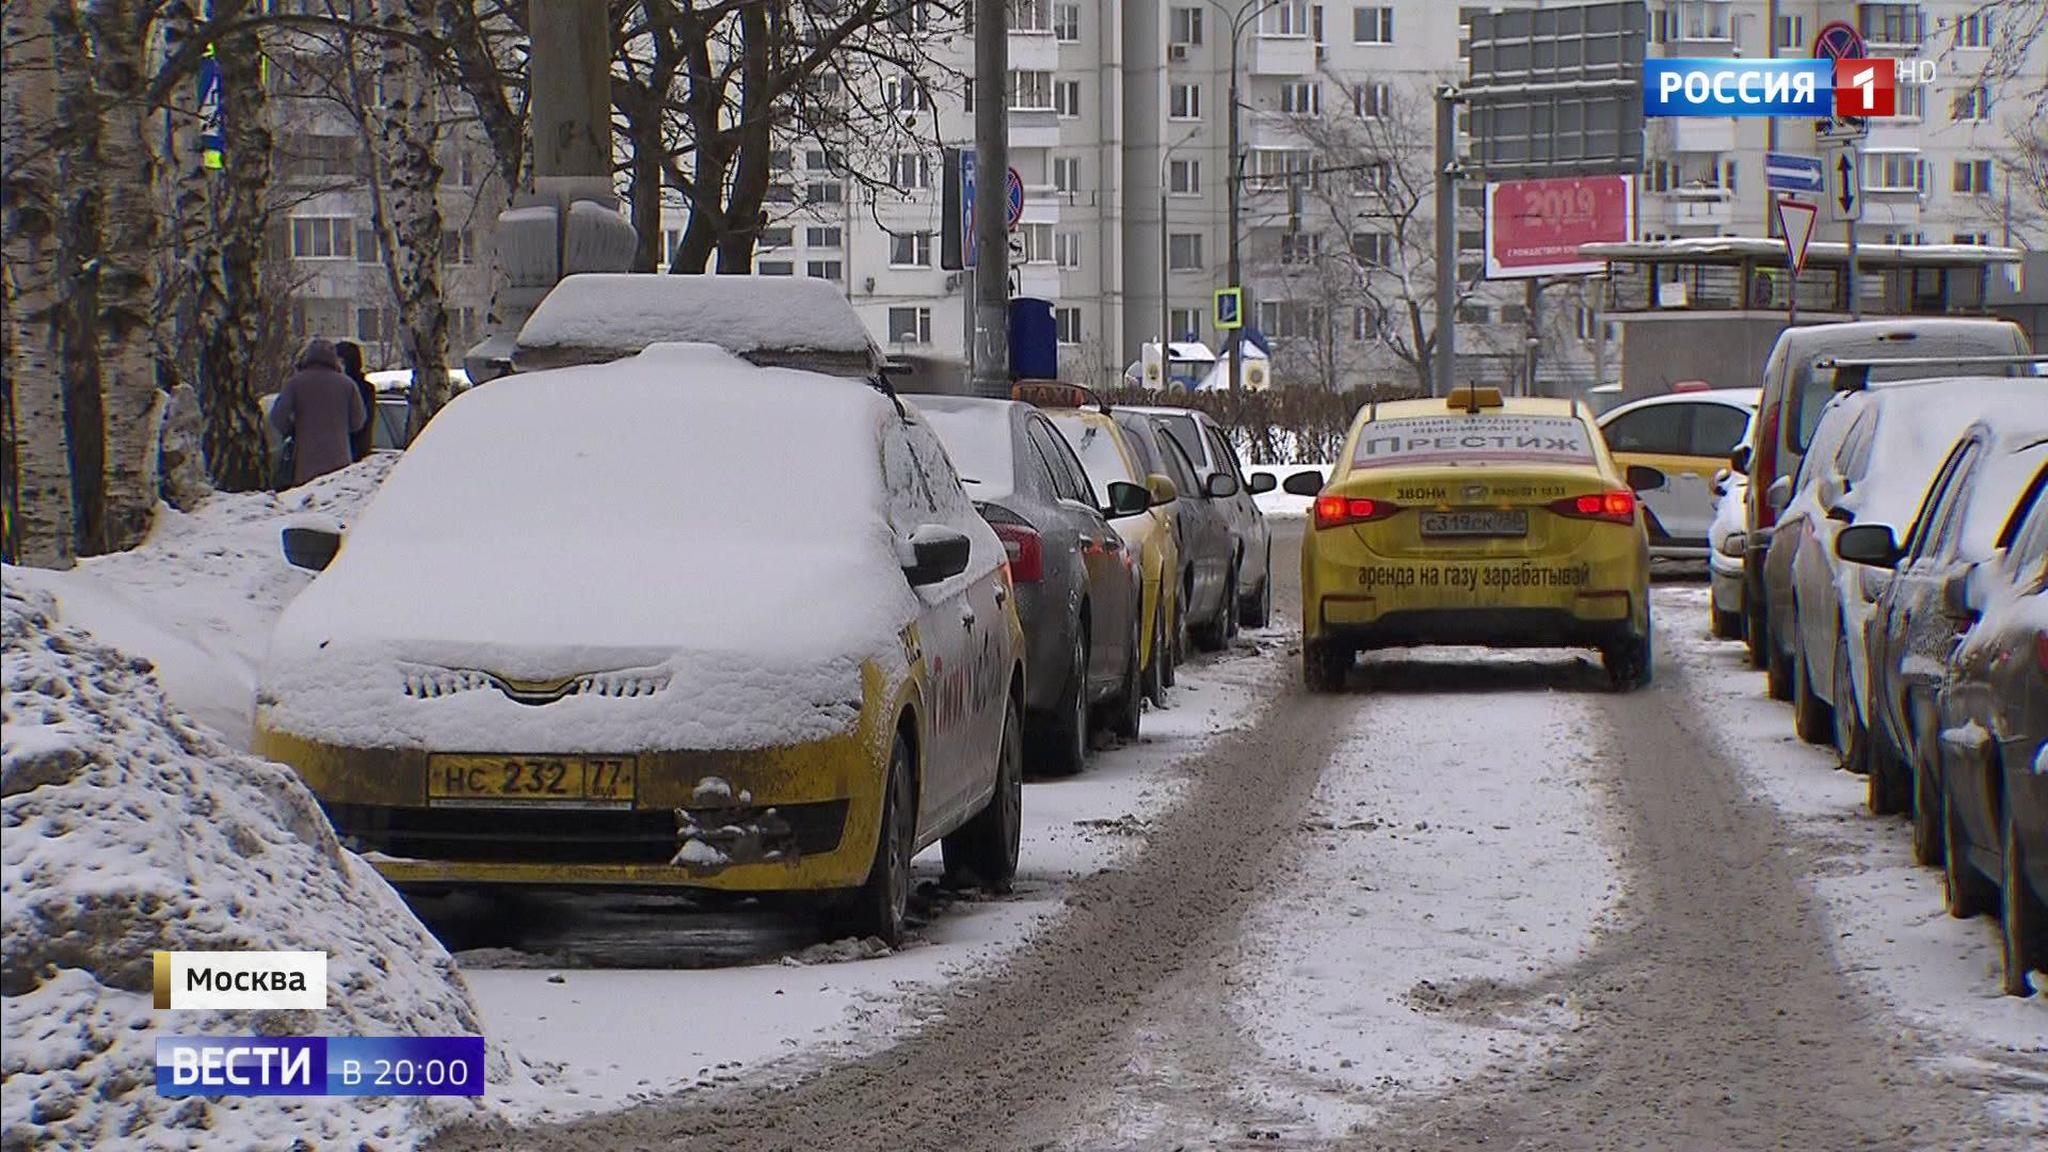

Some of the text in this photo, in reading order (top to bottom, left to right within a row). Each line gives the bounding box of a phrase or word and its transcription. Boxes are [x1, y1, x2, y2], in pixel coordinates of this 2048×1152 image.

[1524, 187, 1596, 227] 2019
[1366, 435, 1580, 454] ПРЕСТИЖ
[1396, 487, 1447, 499] ЗВОНИ
[1358, 562, 1590, 591] аренда на газу зарабатывай
[503, 762, 566, 793] 232
[589, 761, 623, 784] 77
